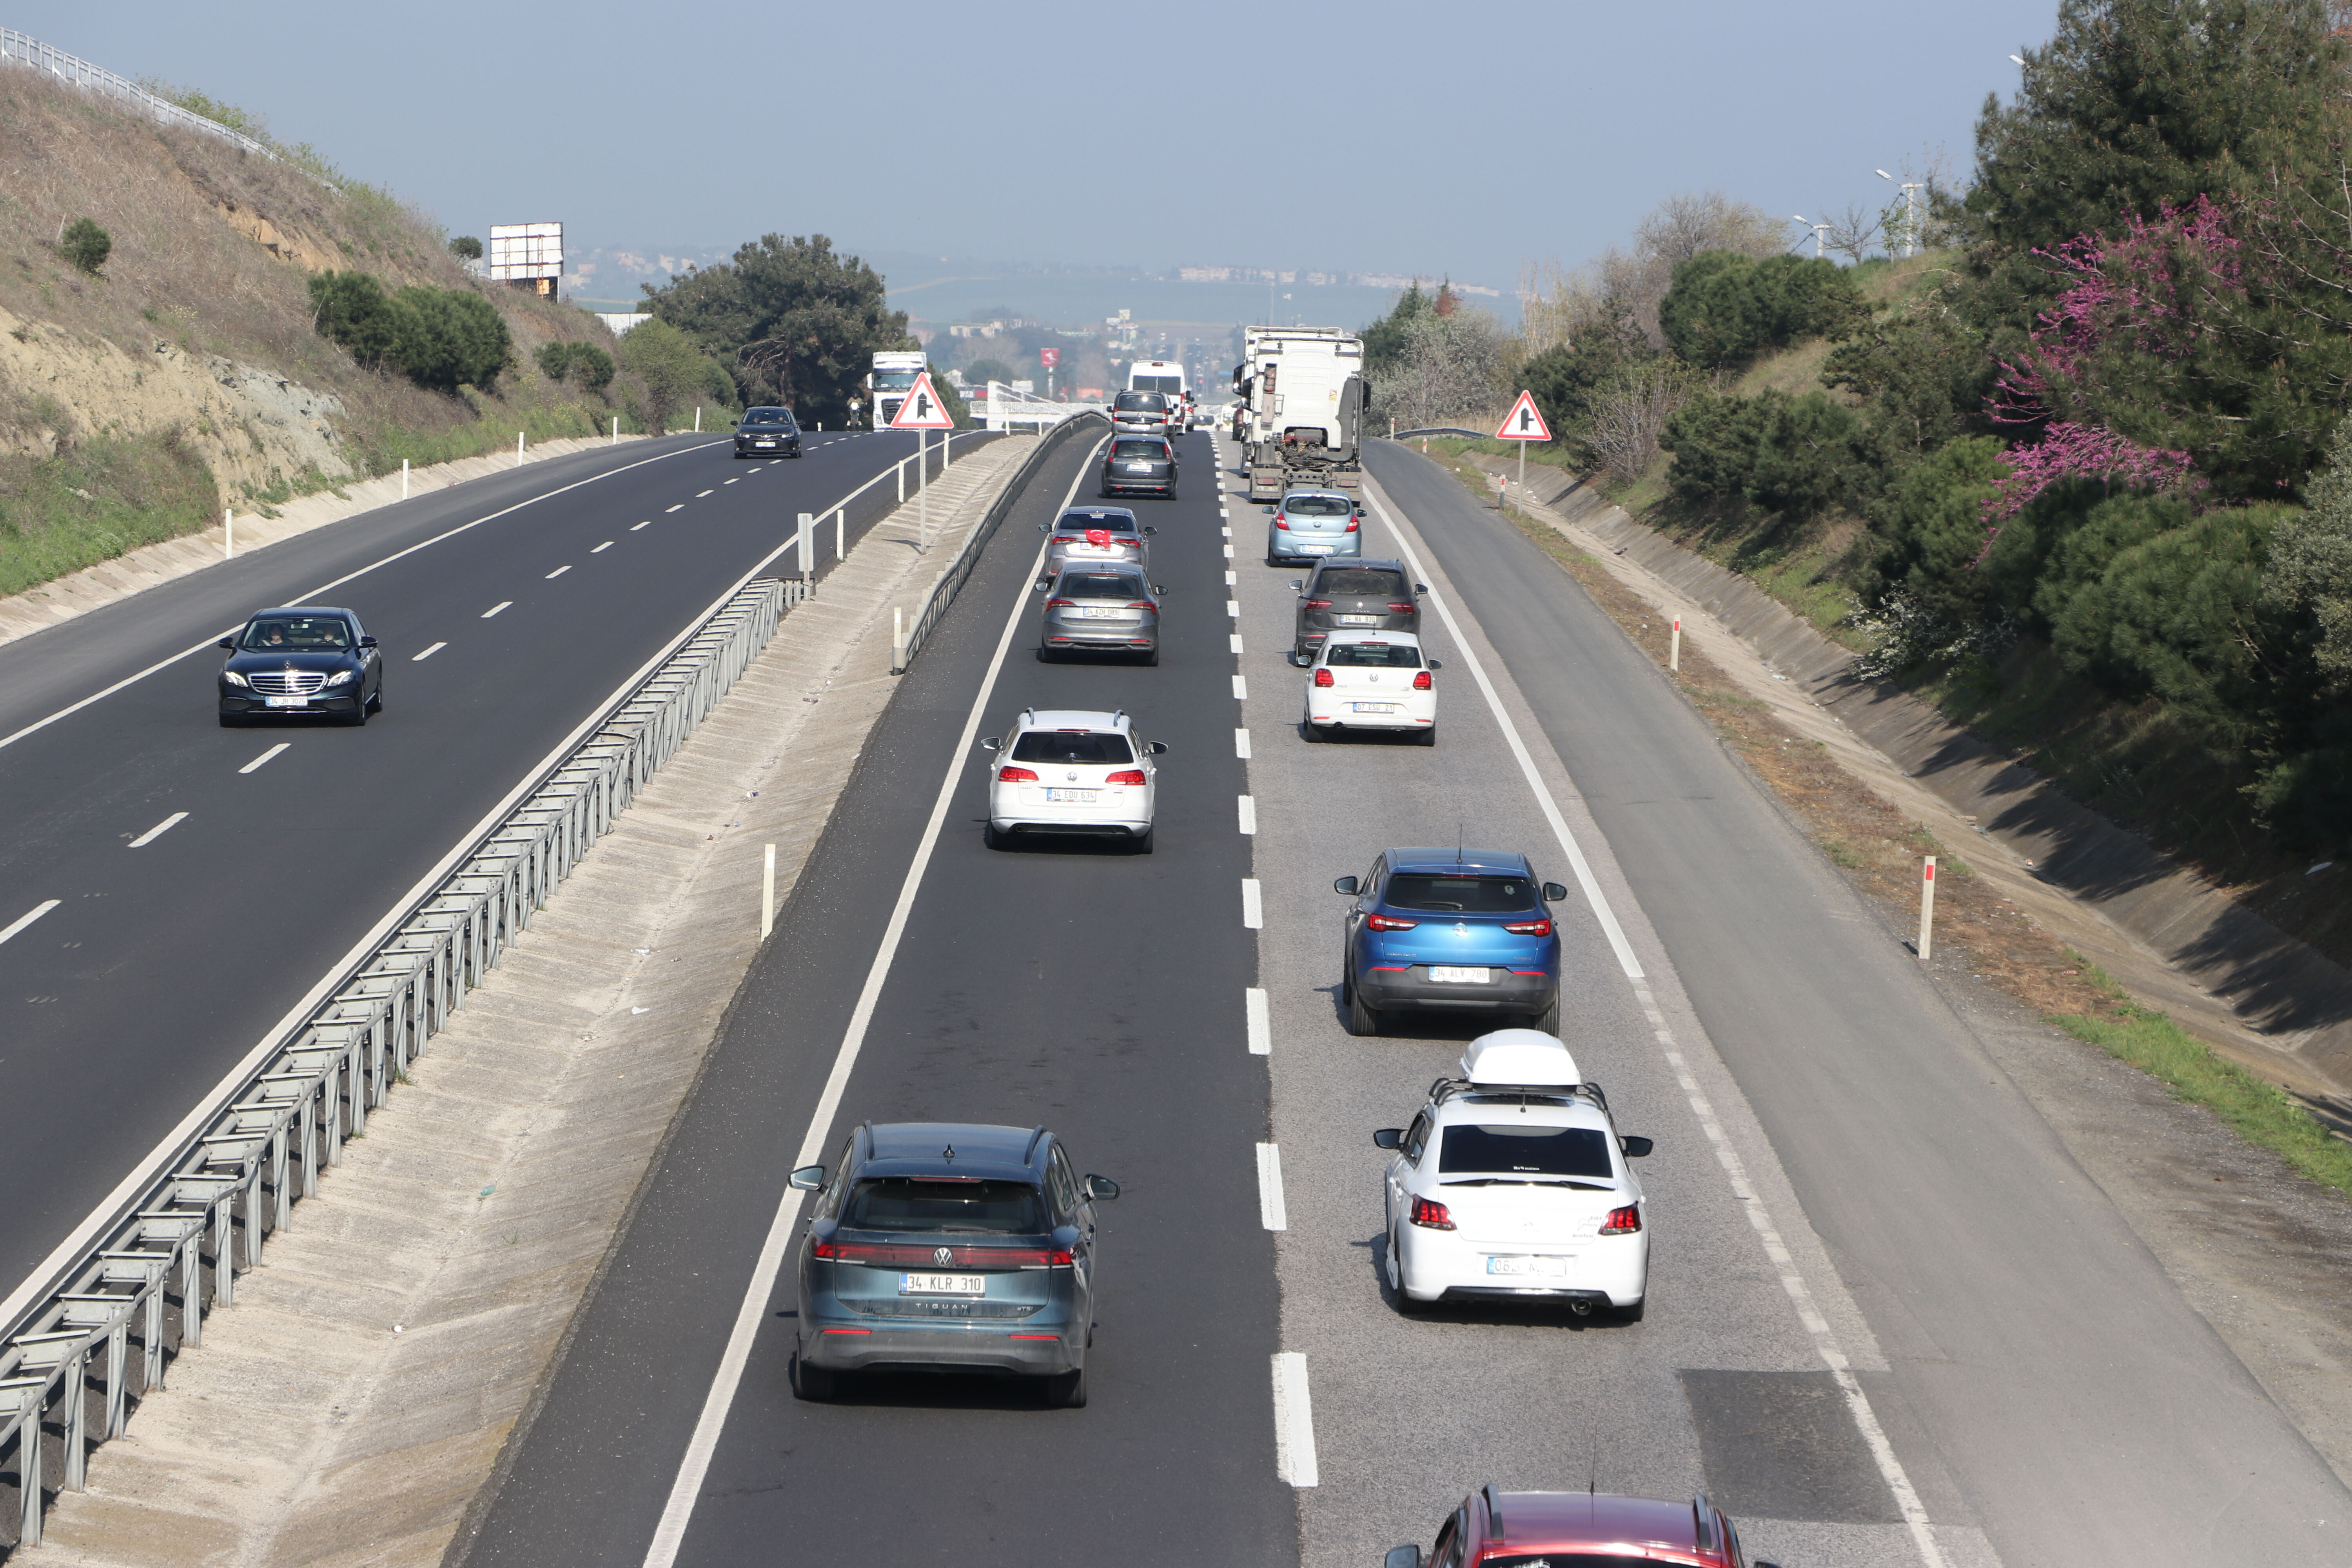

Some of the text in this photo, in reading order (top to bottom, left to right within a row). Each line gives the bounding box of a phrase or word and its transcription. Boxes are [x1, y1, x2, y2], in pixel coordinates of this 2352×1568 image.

[1436, 968, 1487, 978] 34 ALV 780
[1495, 1259, 1509, 1271] 06
[909, 1276, 922, 1289] 34
[930, 1277, 952, 1290] KLR
[961, 1278, 981, 1291] 310
